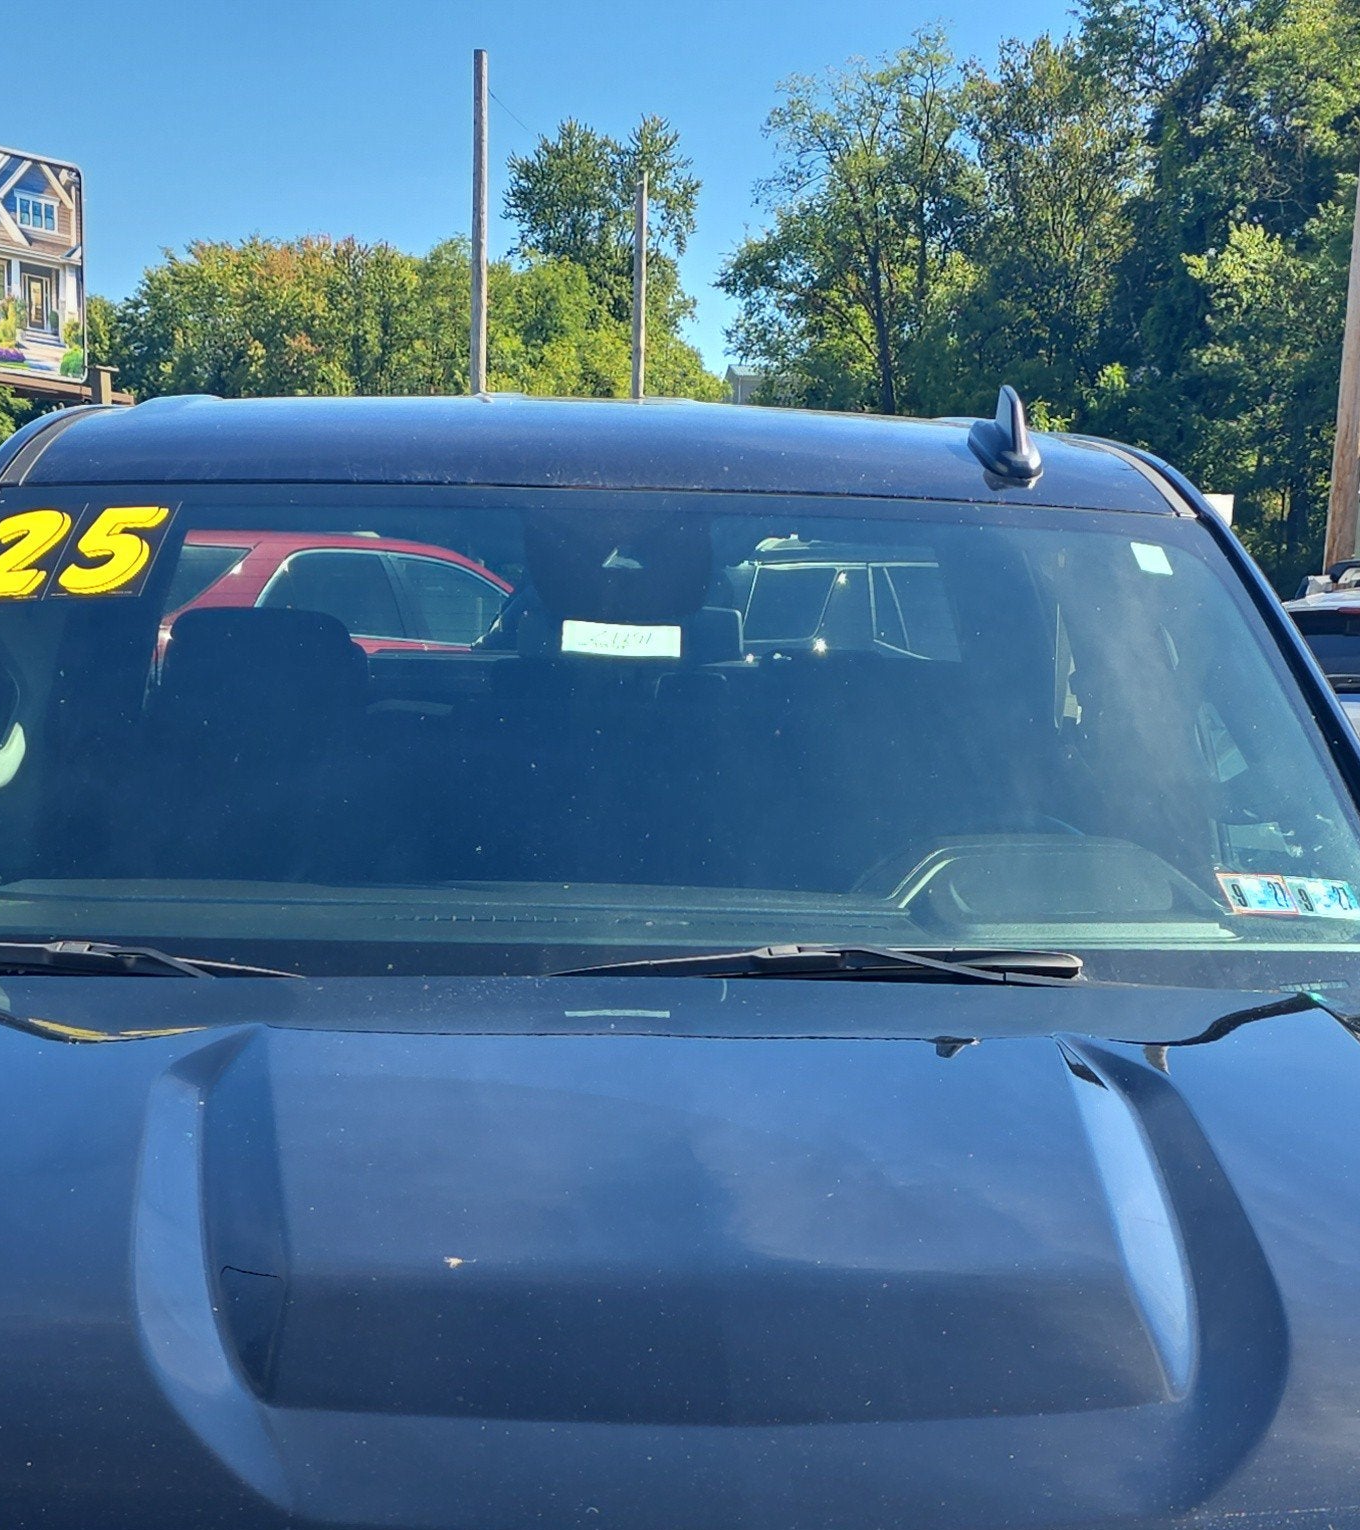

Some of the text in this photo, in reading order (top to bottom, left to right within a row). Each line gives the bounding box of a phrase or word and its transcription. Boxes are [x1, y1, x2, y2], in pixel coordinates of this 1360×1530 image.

[1231, 881, 1353, 912] 9 27 9 27
